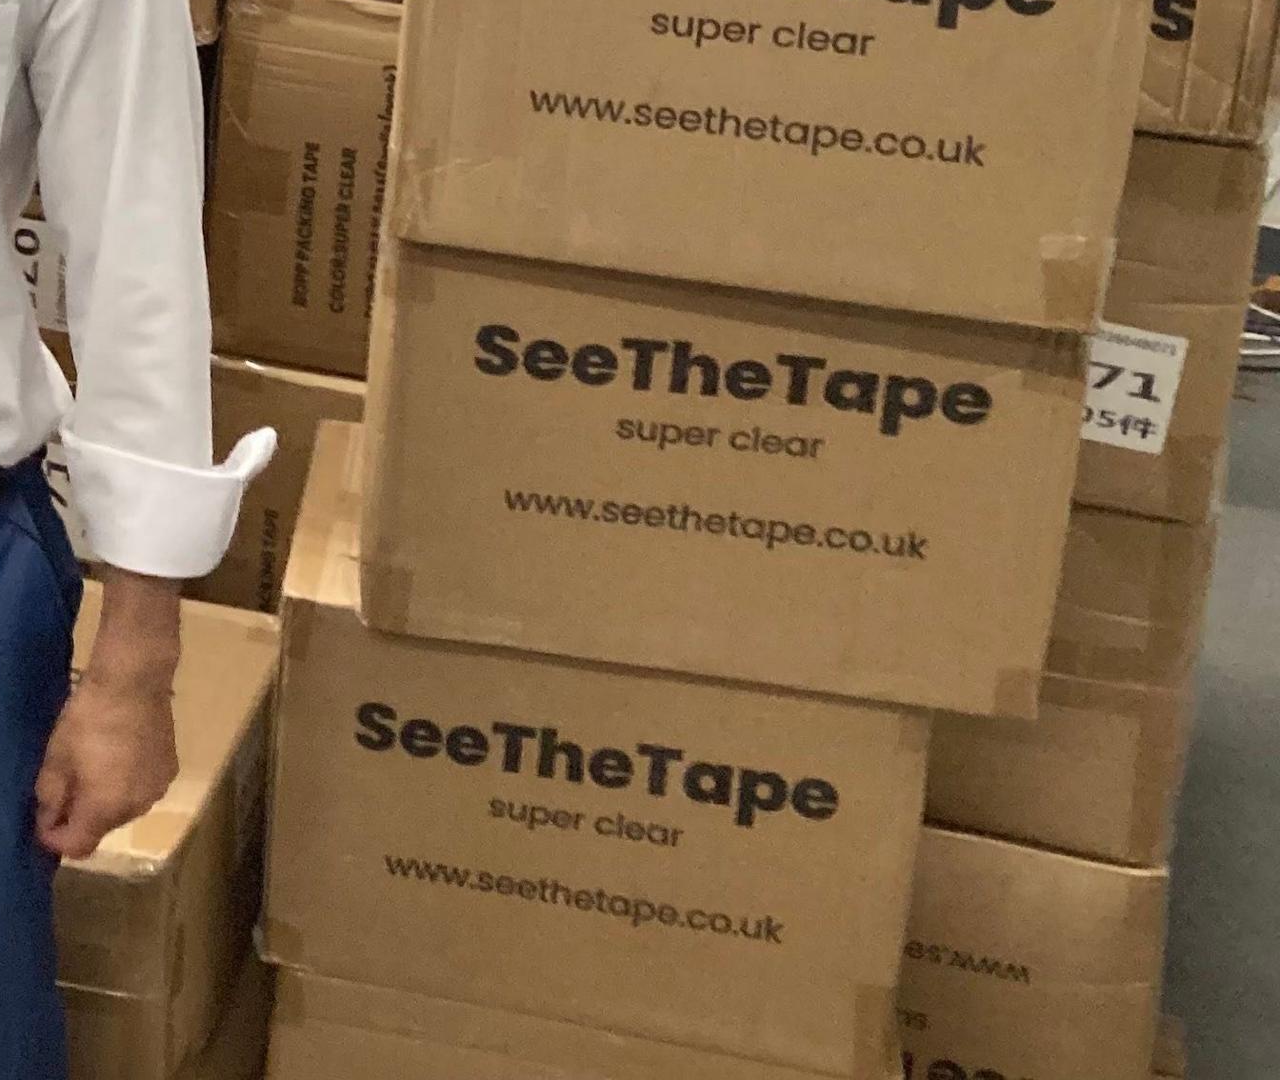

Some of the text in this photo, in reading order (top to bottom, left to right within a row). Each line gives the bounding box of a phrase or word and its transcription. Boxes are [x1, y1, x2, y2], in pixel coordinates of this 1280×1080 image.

[650, 11, 875, 57] super clear
[302, 141, 321, 185] TAPE
[529, 88, 987, 168] www.seethetape.co.uk
[339, 146, 359, 201] CLEAR
[295, 186, 317, 262] PACKING
[474, 324, 993, 437] SeeTheTape
[615, 417, 825, 460] super clear
[503, 487, 929, 561] www.seethetape.co.uk
[354, 700, 839, 828] SeeTheTape
[488, 794, 685, 849] super clear
[384, 851, 783, 945] www.seethetape.co.uk
